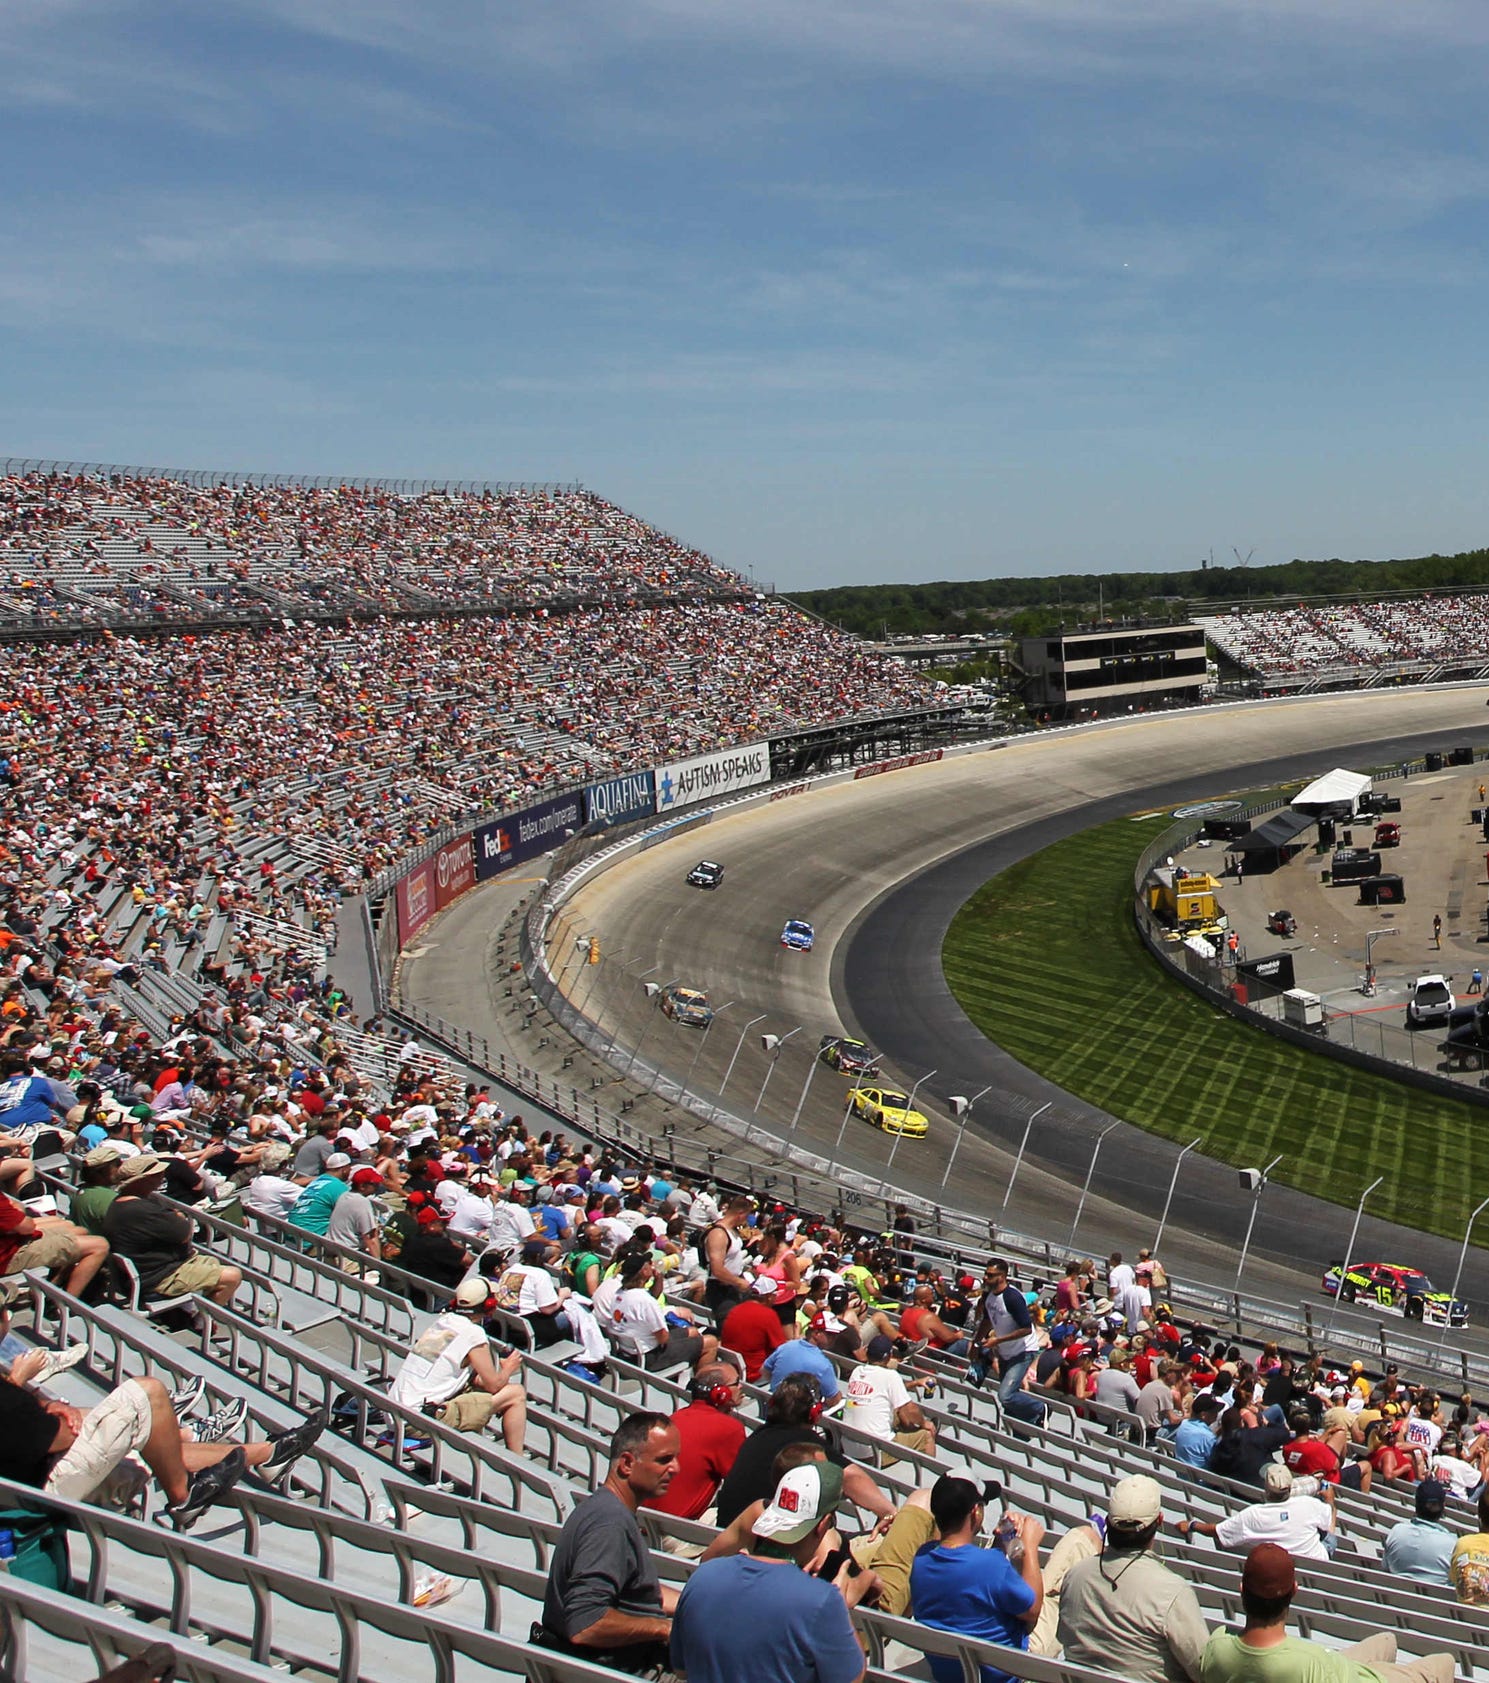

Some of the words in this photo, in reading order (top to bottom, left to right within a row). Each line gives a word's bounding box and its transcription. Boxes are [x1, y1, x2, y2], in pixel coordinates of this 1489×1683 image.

[678, 763, 720, 795] AUTISM
[722, 752, 762, 782] SPEAKS
[589, 773, 651, 822] AQUAFINA
[769, 784, 804, 801] DOVER
[519, 803, 577, 844] fedex.com/onerate
[448, 840, 472, 873] TOYOTA
[483, 828, 513, 858] FedEx
[1375, 1285, 1393, 1307] 15
